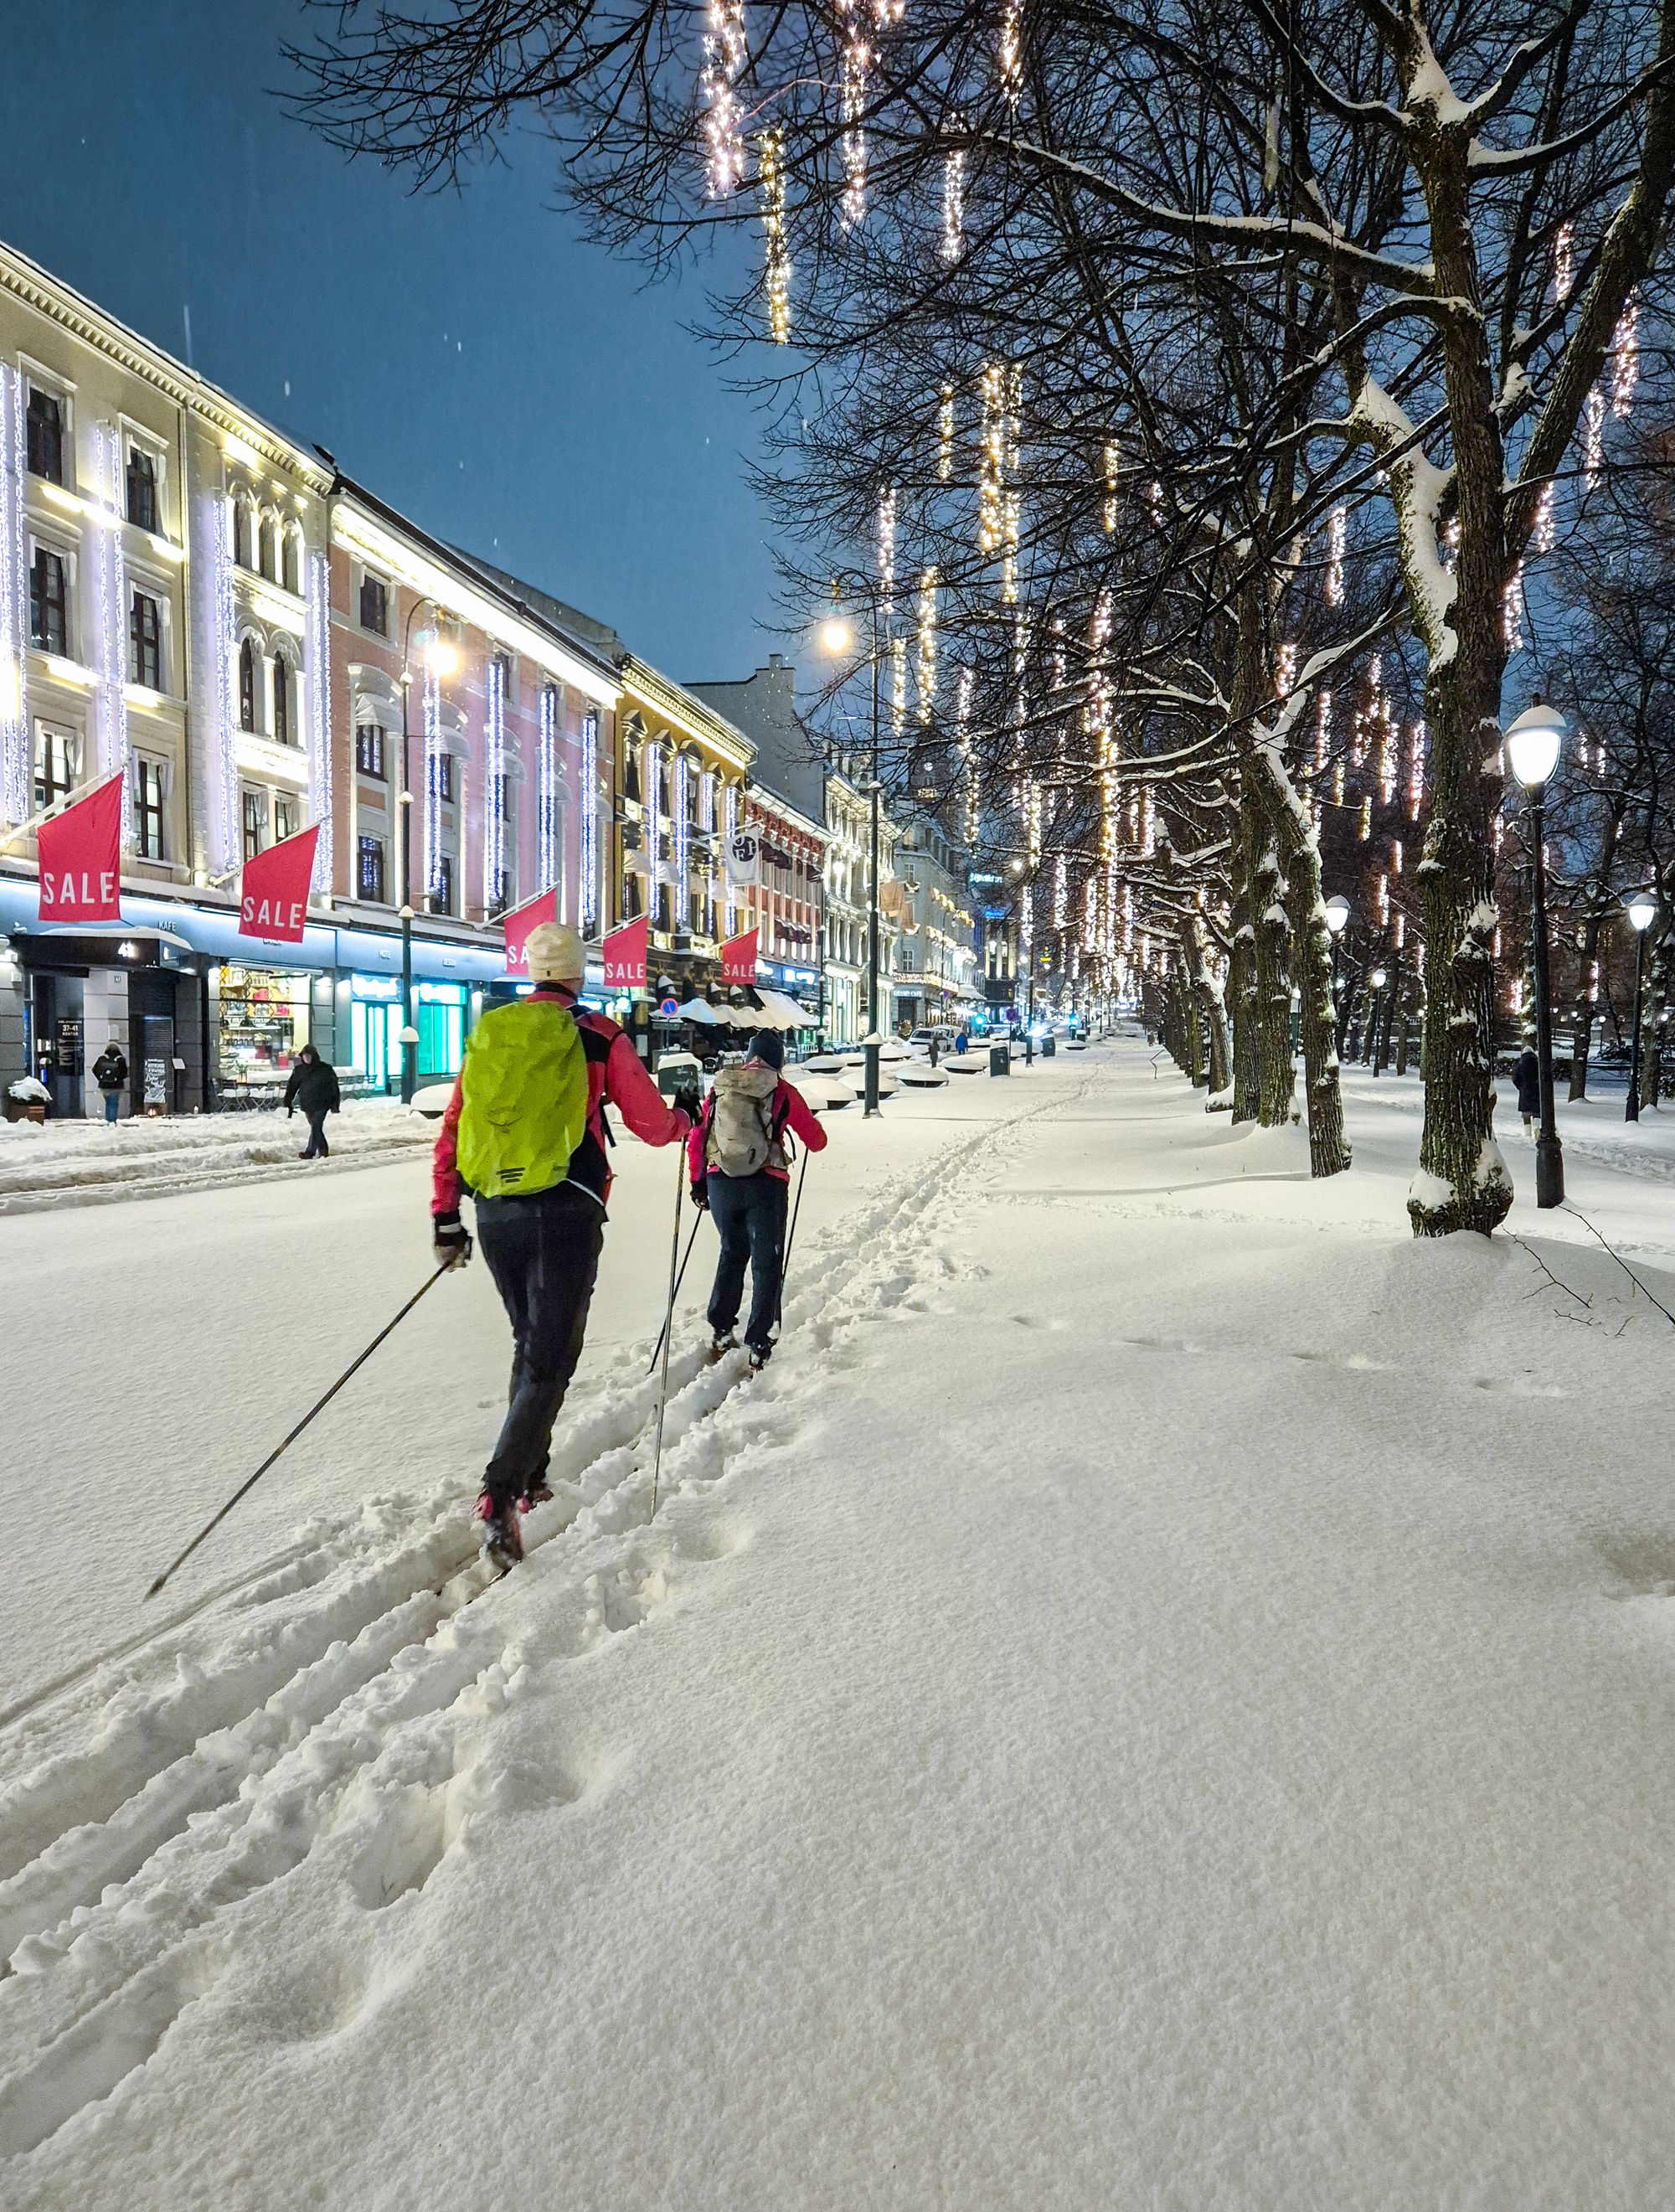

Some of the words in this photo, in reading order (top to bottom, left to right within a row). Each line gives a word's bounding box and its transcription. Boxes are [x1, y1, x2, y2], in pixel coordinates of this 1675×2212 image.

[43, 871, 116, 905] SALE
[243, 896, 303, 929] SALE
[158, 920, 177, 931] KAFE
[508, 945, 529, 964] SA
[606, 962, 644, 979] SALE
[724, 963, 755, 977] SALE
